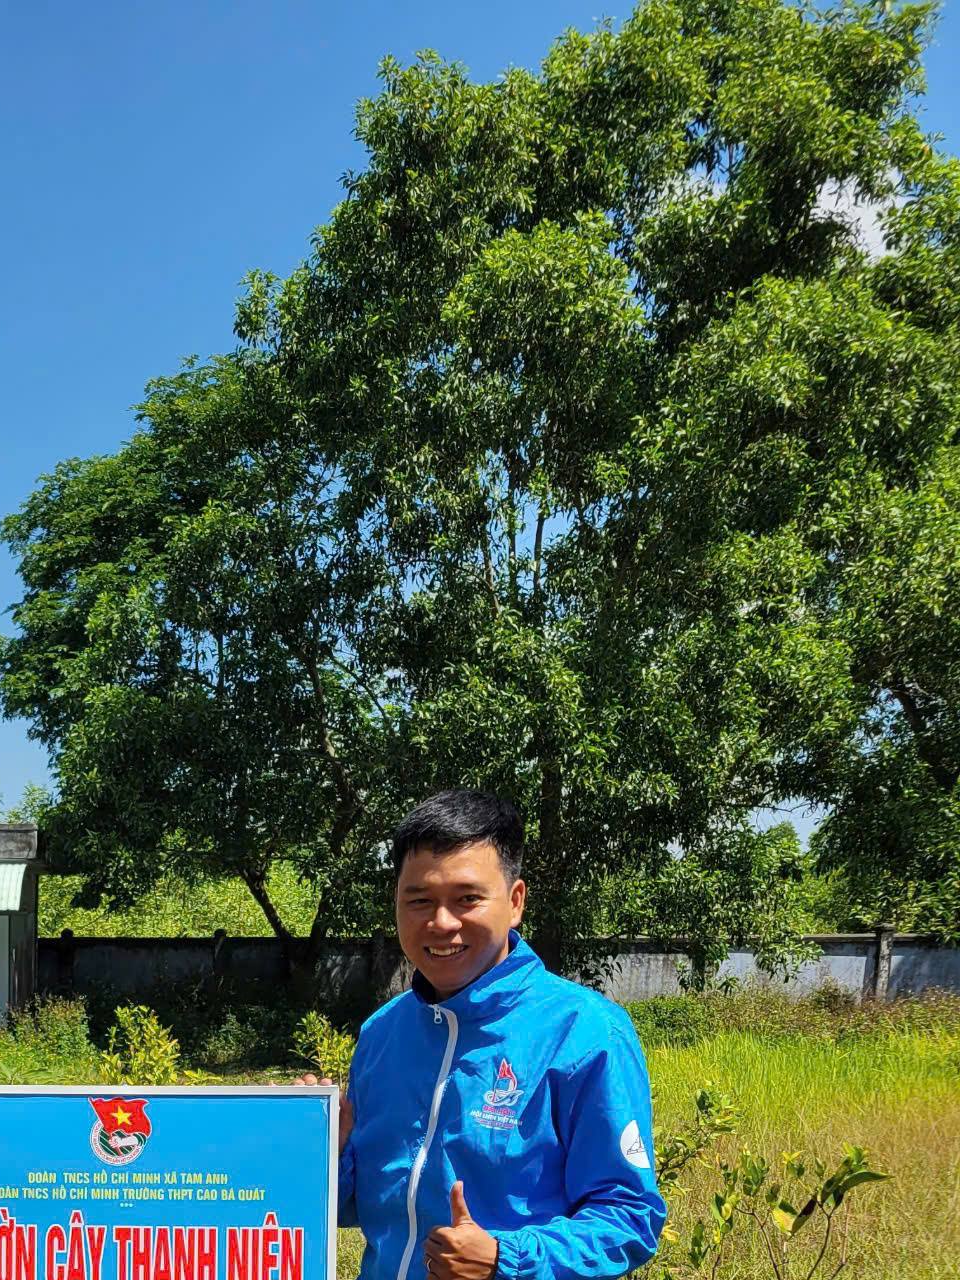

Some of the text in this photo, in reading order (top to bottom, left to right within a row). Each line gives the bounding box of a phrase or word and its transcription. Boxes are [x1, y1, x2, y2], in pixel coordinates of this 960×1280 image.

[63, 1172, 90, 1184] TNCS
[132, 1172, 161, 1184] MINH
[180, 1173, 203, 1185] TAM
[22, 1187, 49, 1199] TNCS
[91, 1188, 120, 1200] MINH
[168, 1188, 194, 1200] THPT
[196, 1188, 218, 1201] CAO
